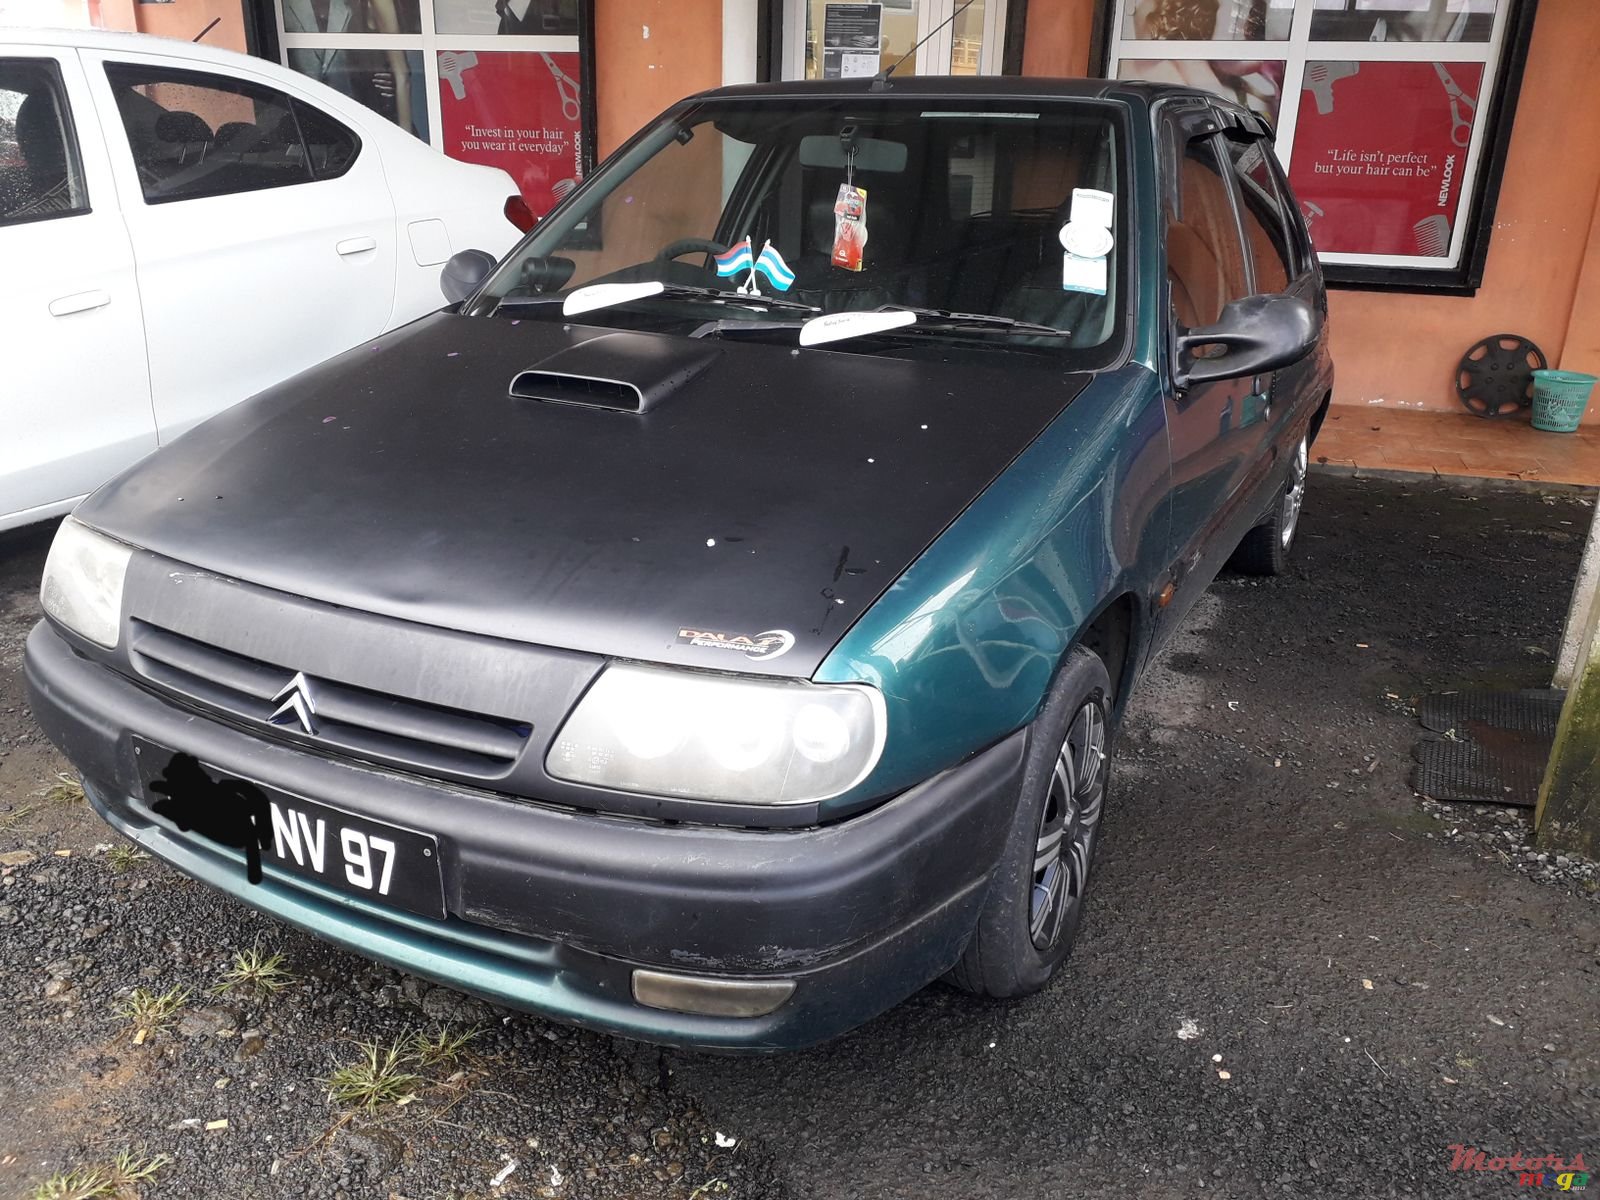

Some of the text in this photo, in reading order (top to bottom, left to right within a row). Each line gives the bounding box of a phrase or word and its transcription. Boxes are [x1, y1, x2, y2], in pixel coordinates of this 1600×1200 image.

[465, 125, 564, 141] “Invest in your hair
[461, 139, 569, 155] you wear it everyday”
[575, 131, 583, 177] NEWLOOK
[1327, 149, 1427, 165] “Life isn’t perfect
[1314, 162, 1437, 177] but your hair can be”
[1437, 154, 1456, 207] NEWLOOK
[270, 802, 396, 895] NV 97
